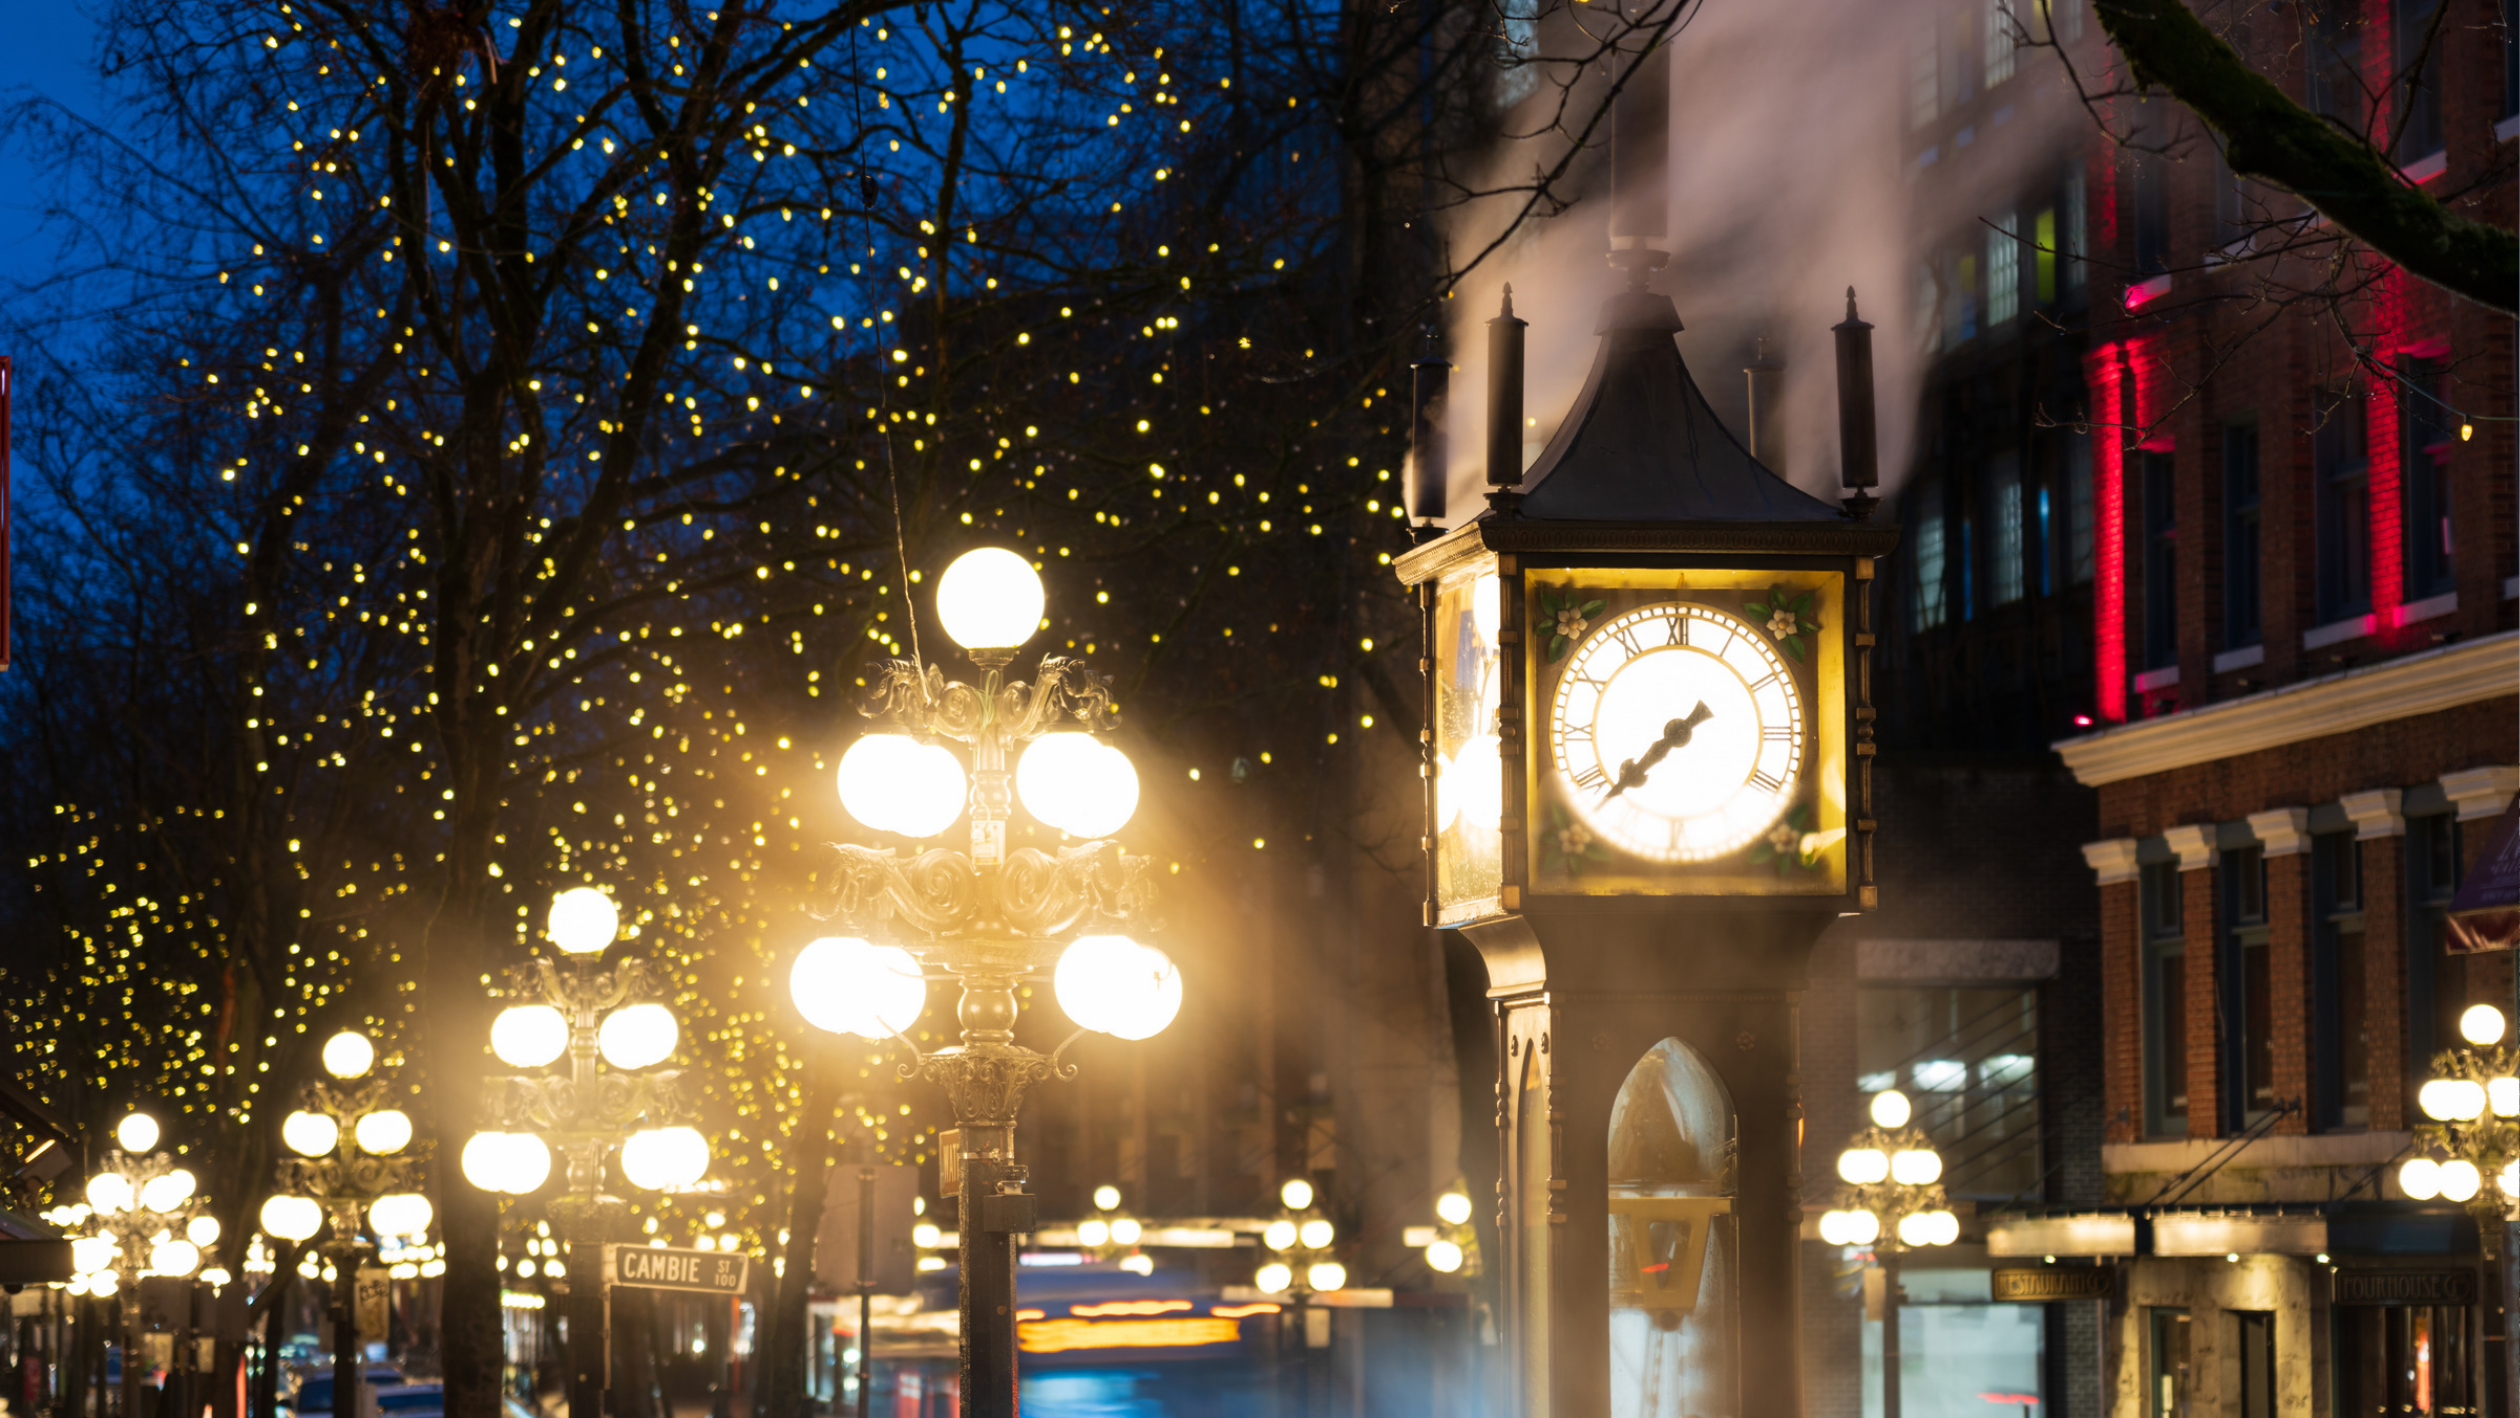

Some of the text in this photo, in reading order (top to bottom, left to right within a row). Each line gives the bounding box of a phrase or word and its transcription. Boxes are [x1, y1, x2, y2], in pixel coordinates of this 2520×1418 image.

[1612, 626, 1643, 661] XI
[1665, 617, 1690, 646] XII
[1718, 632, 1736, 658] I
[1575, 667, 1607, 694] X
[1750, 672, 1778, 692] II
[1564, 722, 1594, 742] IX
[1763, 725, 1792, 741] III
[624, 1253, 731, 1282] CAMBIE ST
[715, 1274, 736, 1287] 100
